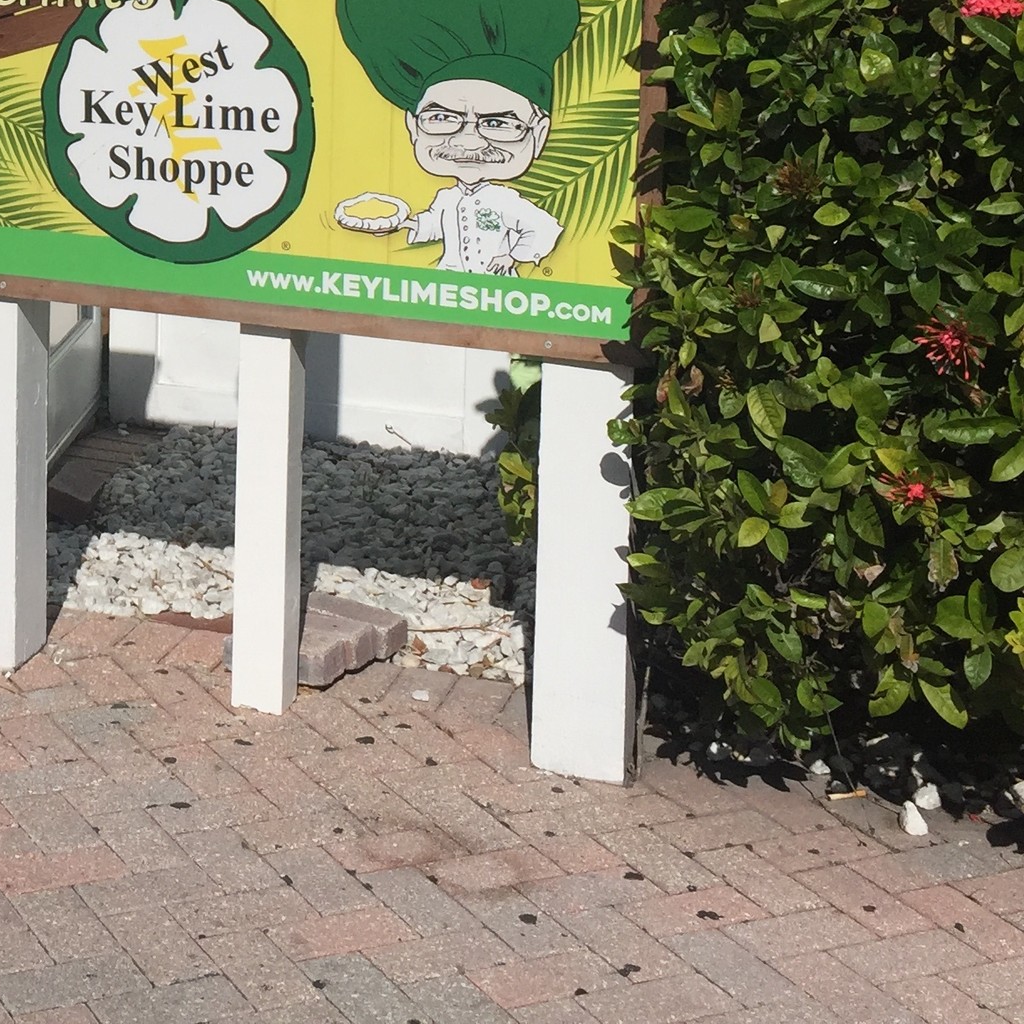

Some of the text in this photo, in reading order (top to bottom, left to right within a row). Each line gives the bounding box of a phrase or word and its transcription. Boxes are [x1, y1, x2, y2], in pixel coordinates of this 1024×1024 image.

[132, 38, 235, 97] West
[80, 88, 281, 136] Key Lime
[108, 144, 255, 196] Shoppe
